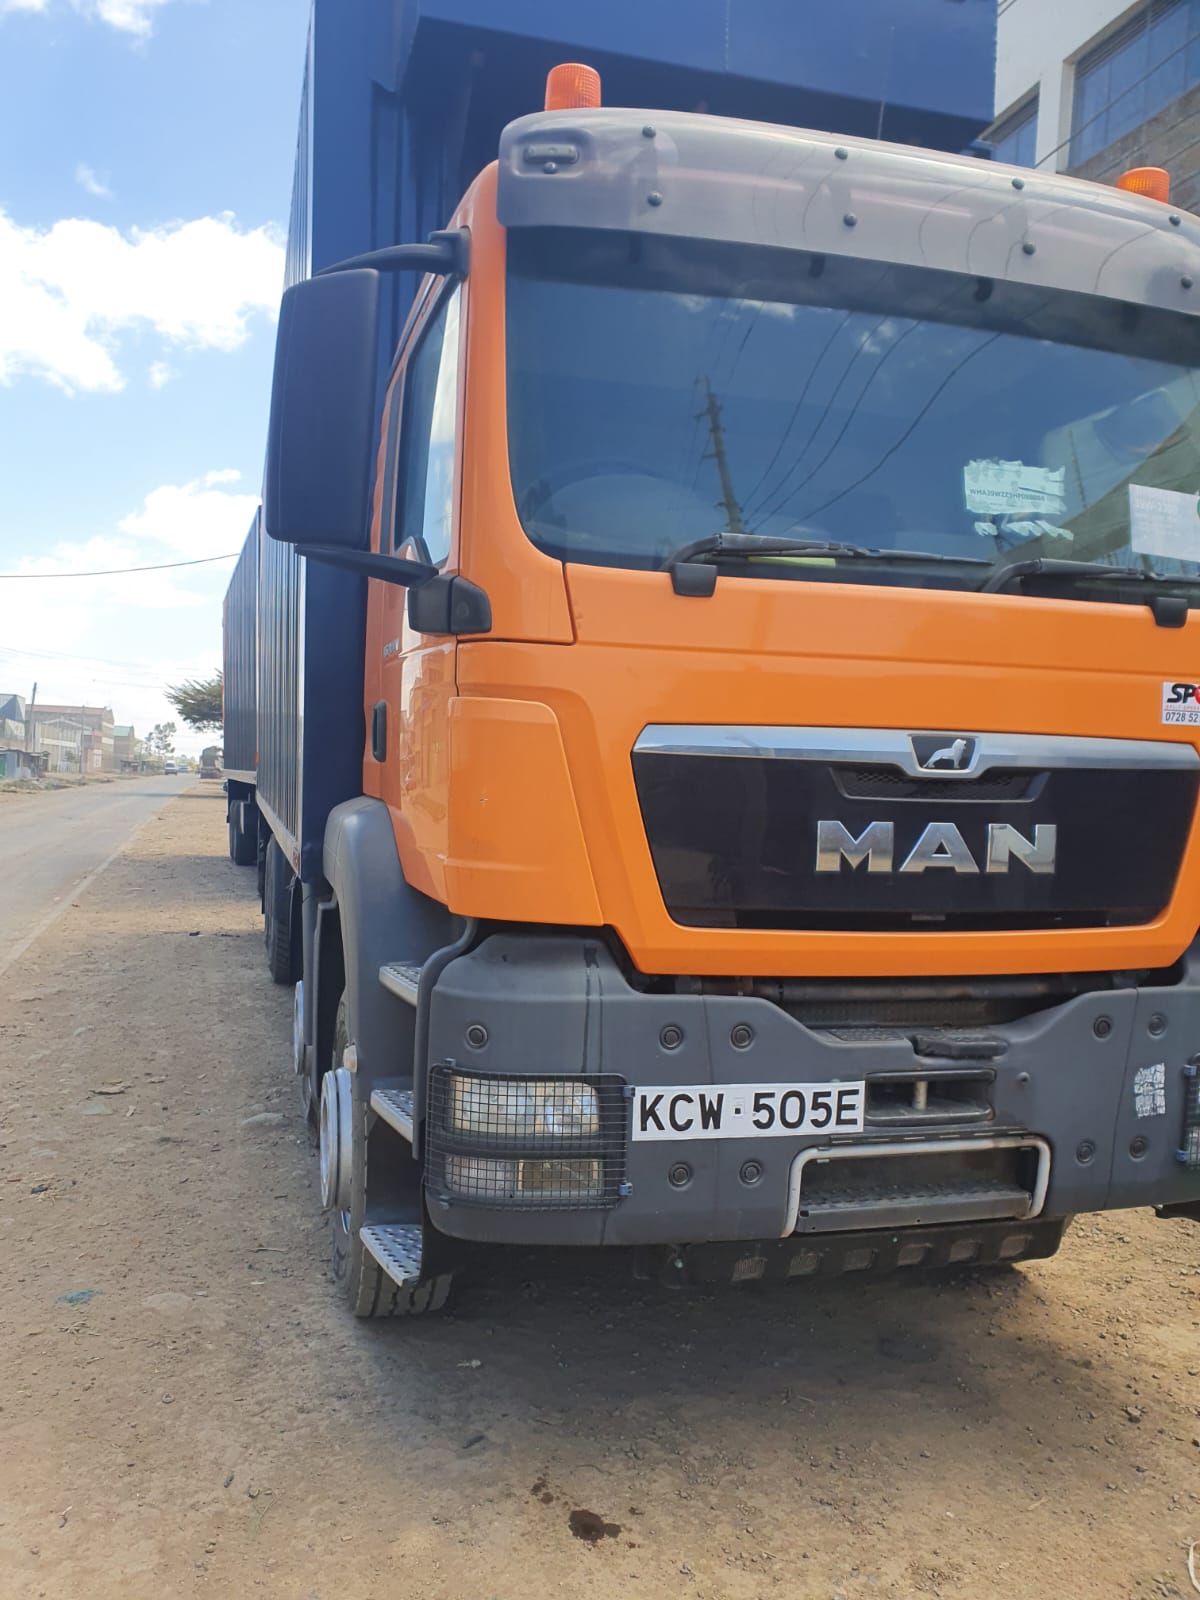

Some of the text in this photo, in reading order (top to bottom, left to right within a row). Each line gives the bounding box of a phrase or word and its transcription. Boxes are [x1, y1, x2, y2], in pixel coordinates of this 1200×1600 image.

[1165, 712, 1186, 722] 0728
[816, 820, 1057, 874] MAN
[640, 1088, 860, 1132] KCW 505E
